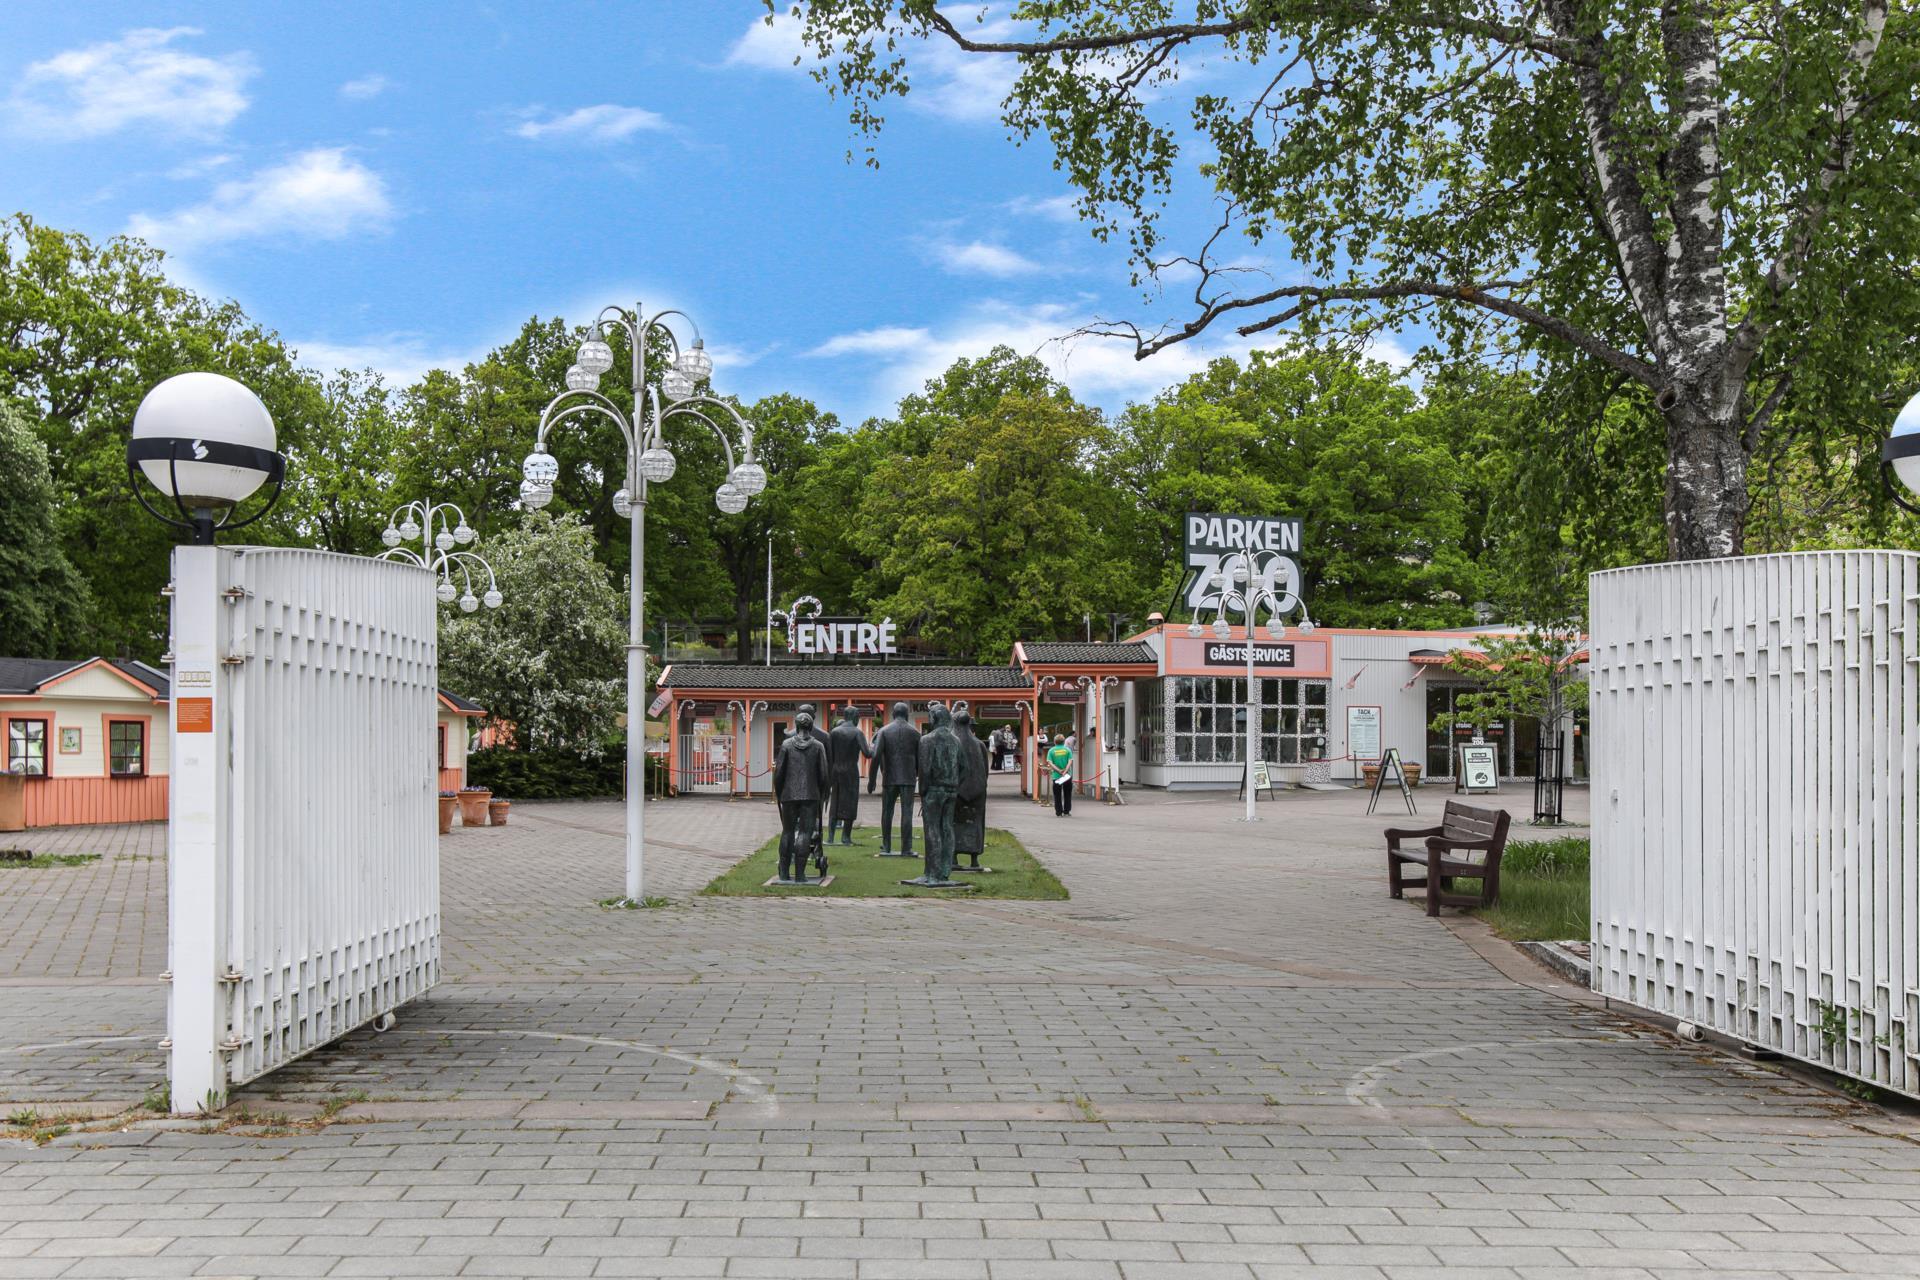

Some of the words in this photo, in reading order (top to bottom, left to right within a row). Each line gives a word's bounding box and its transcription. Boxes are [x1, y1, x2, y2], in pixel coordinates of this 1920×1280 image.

[1189, 516, 1299, 552] PARKEN
[1188, 553, 1300, 613] ZOO
[797, 616, 897, 654] ENTRÉ
